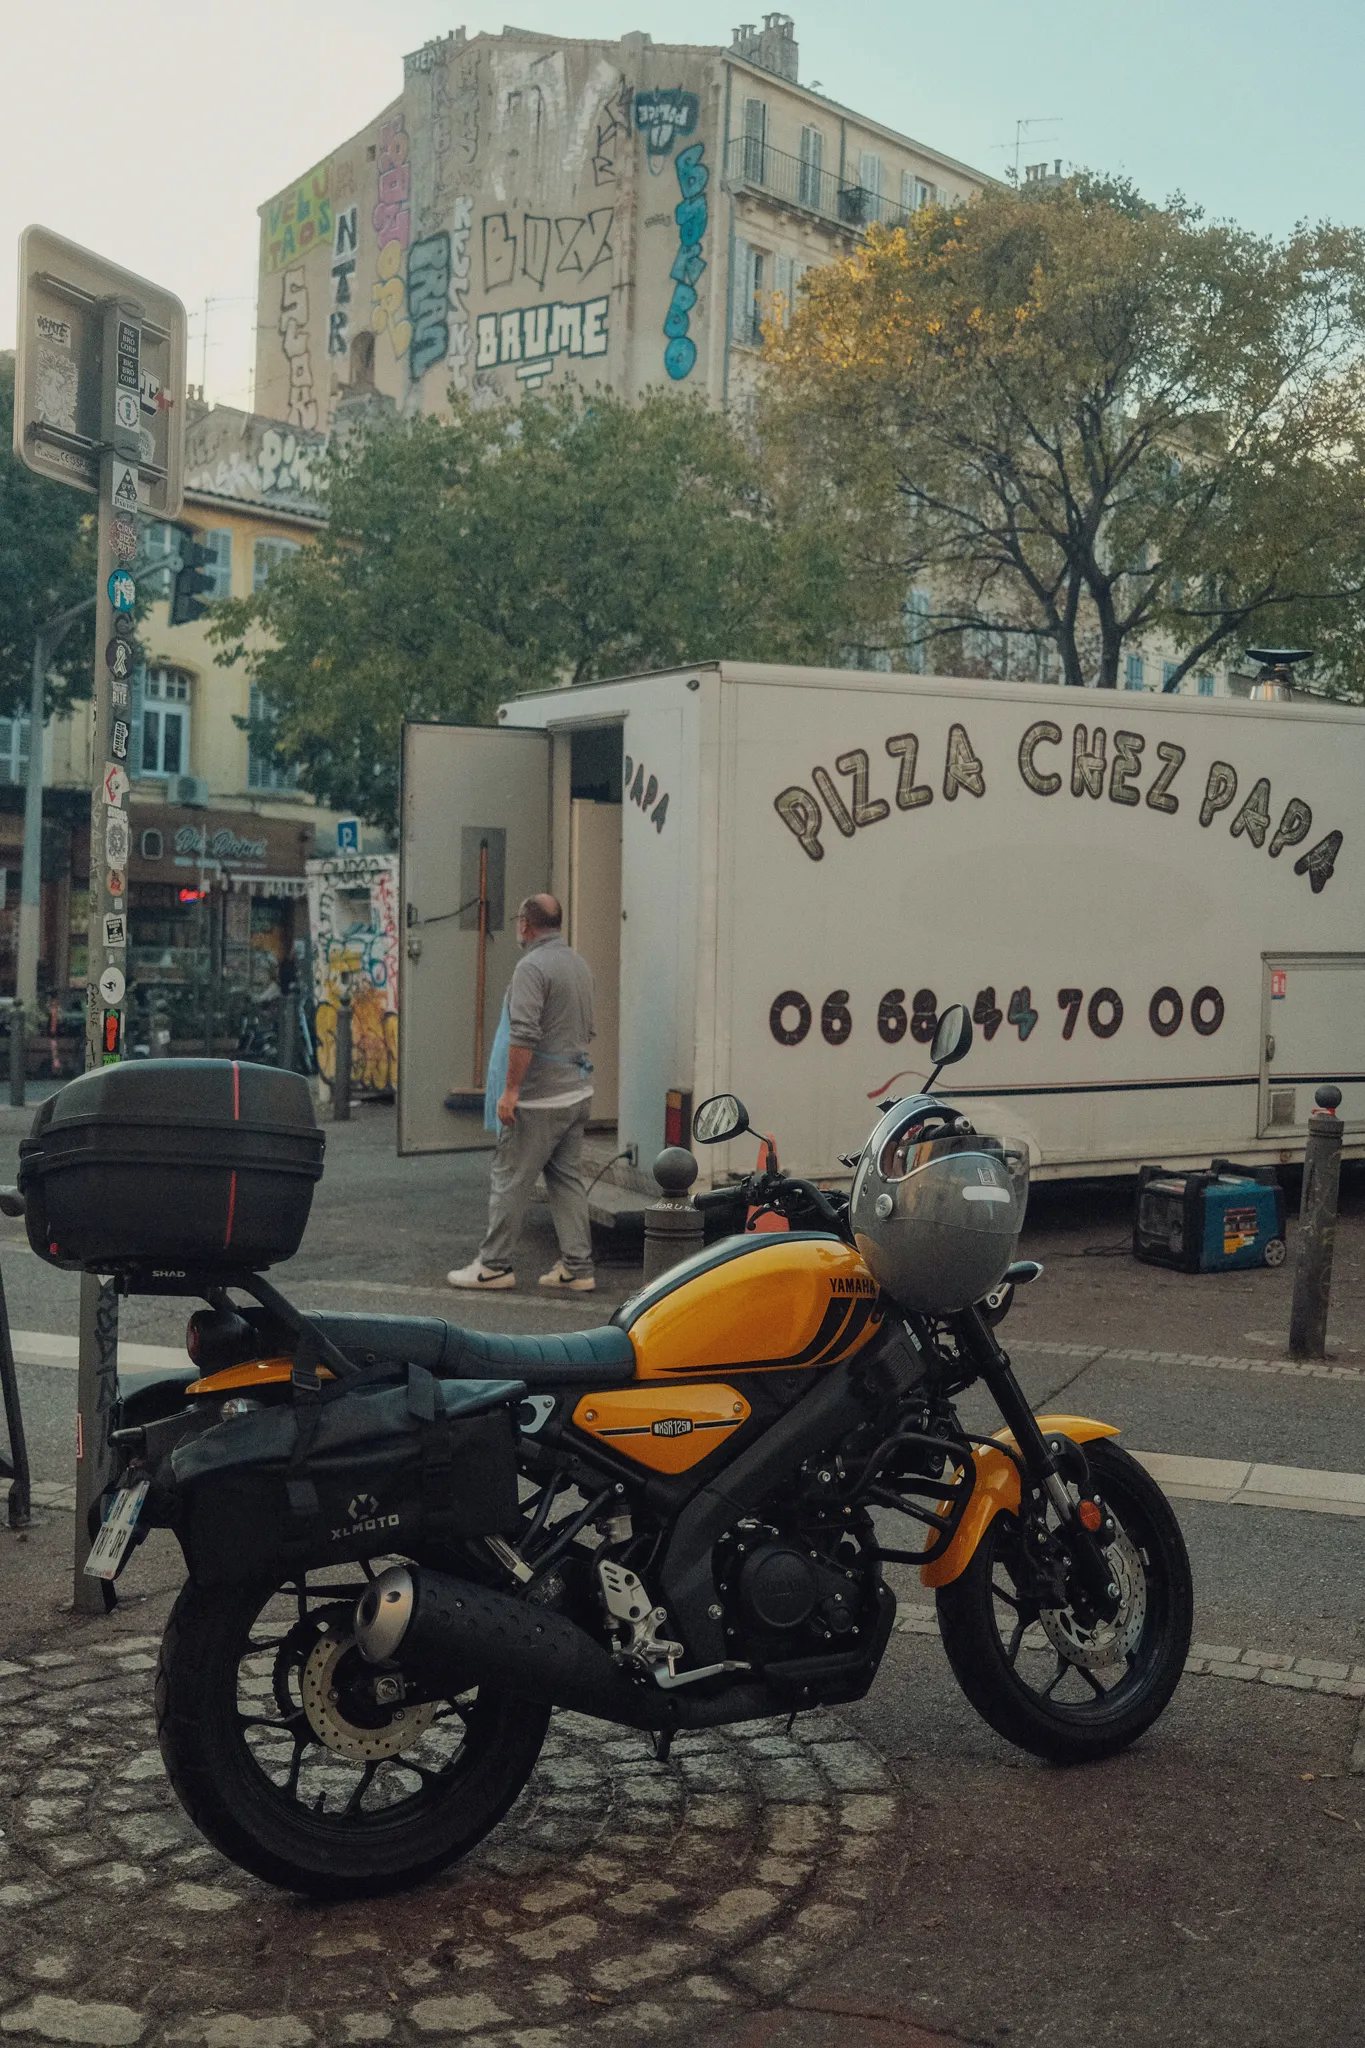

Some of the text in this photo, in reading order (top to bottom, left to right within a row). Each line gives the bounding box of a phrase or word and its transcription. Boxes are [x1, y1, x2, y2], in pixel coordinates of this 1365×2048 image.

[124, 327, 134, 338] BIG
[122, 335, 135, 346] BRO
[120, 342, 137, 354] CORP
[123, 358, 134, 368] BIG
[122, 366, 135, 376] BRO
[120, 374, 137, 385] CORP
[773, 720, 1344, 894] PIZZA CHEZ PAPA
[769, 985, 1225, 1046] 06 68 44 70 00
[152, 1270, 186, 1278] SHAD
[829, 1277, 876, 1294] YAMAHA
[659, 1420, 688, 1435] XSR125
[331, 1513, 399, 1540] XLMOTO
